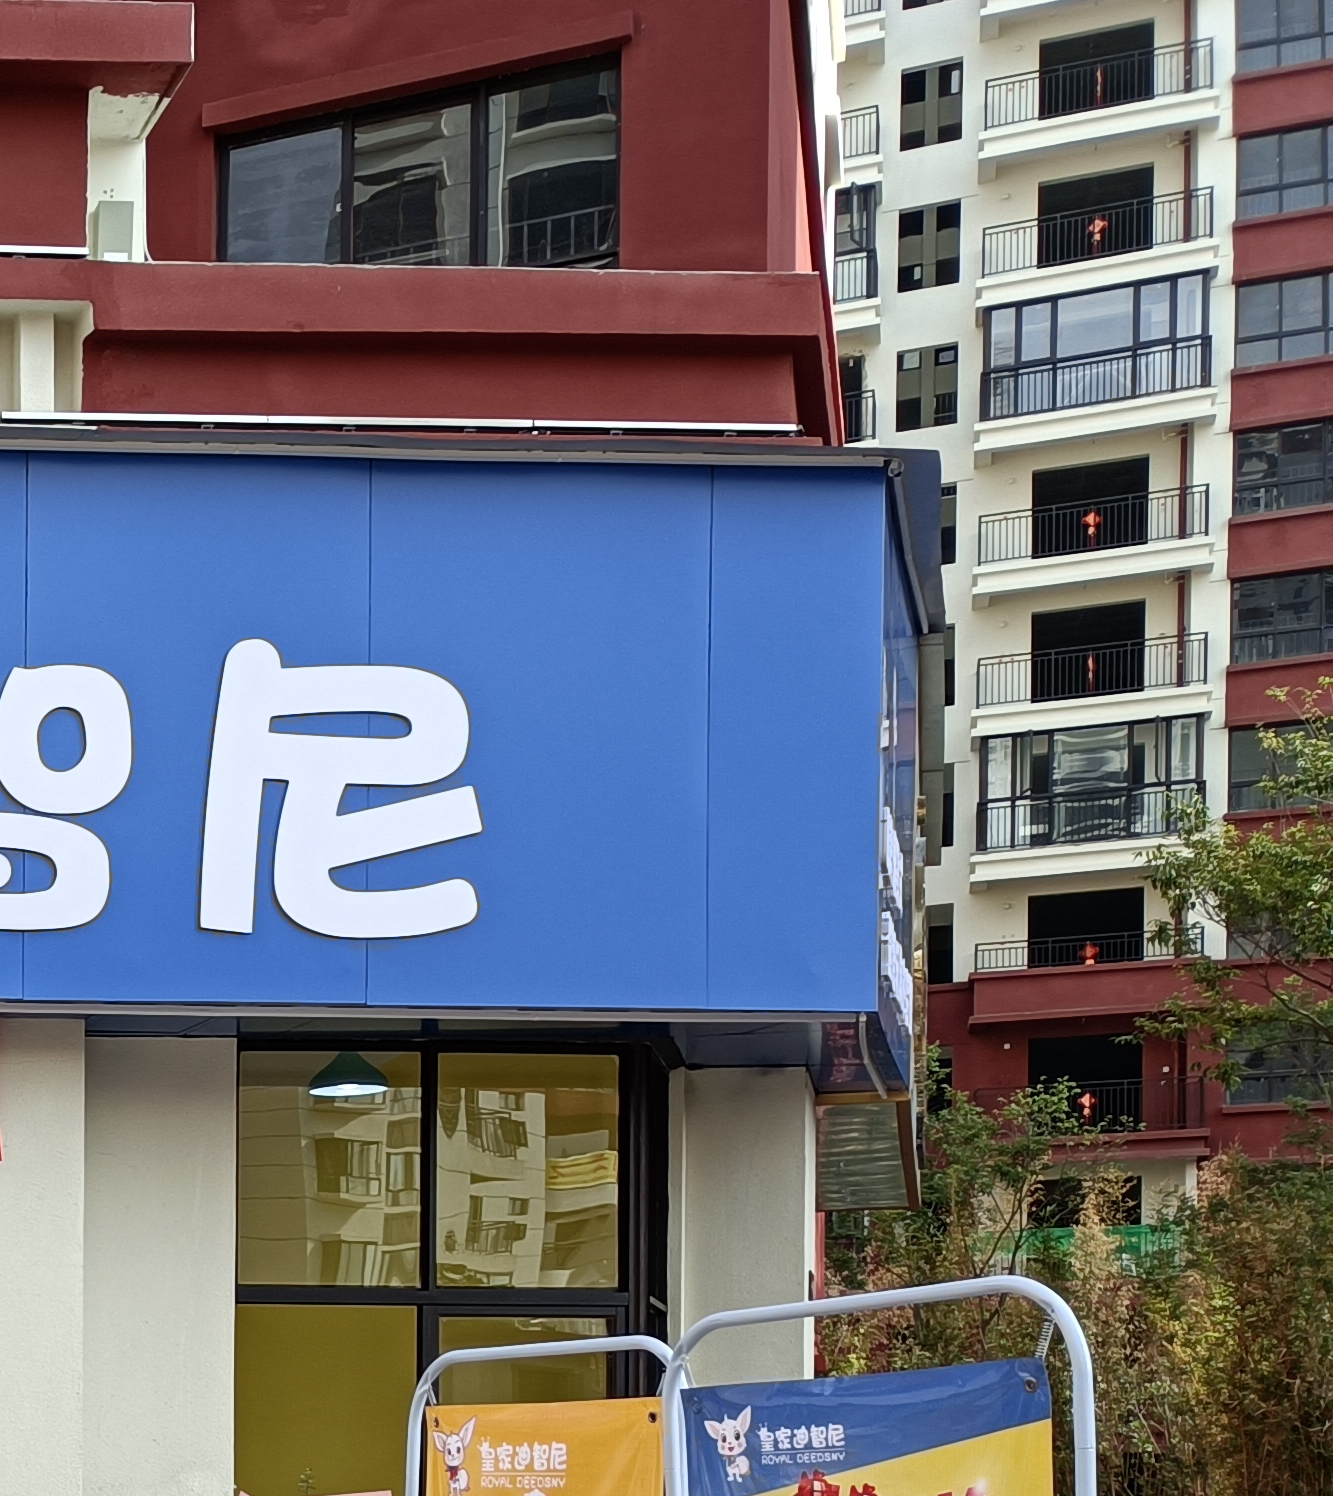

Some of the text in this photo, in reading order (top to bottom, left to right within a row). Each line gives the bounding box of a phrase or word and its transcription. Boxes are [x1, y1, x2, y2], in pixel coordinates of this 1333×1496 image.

[755, 1422, 846, 1451] 皇家迪智尼
[477, 1436, 568, 1472] 皇家迪智尼
[761, 1453, 794, 1466] ROYAL
[480, 1476, 513, 1489] ROYAL
